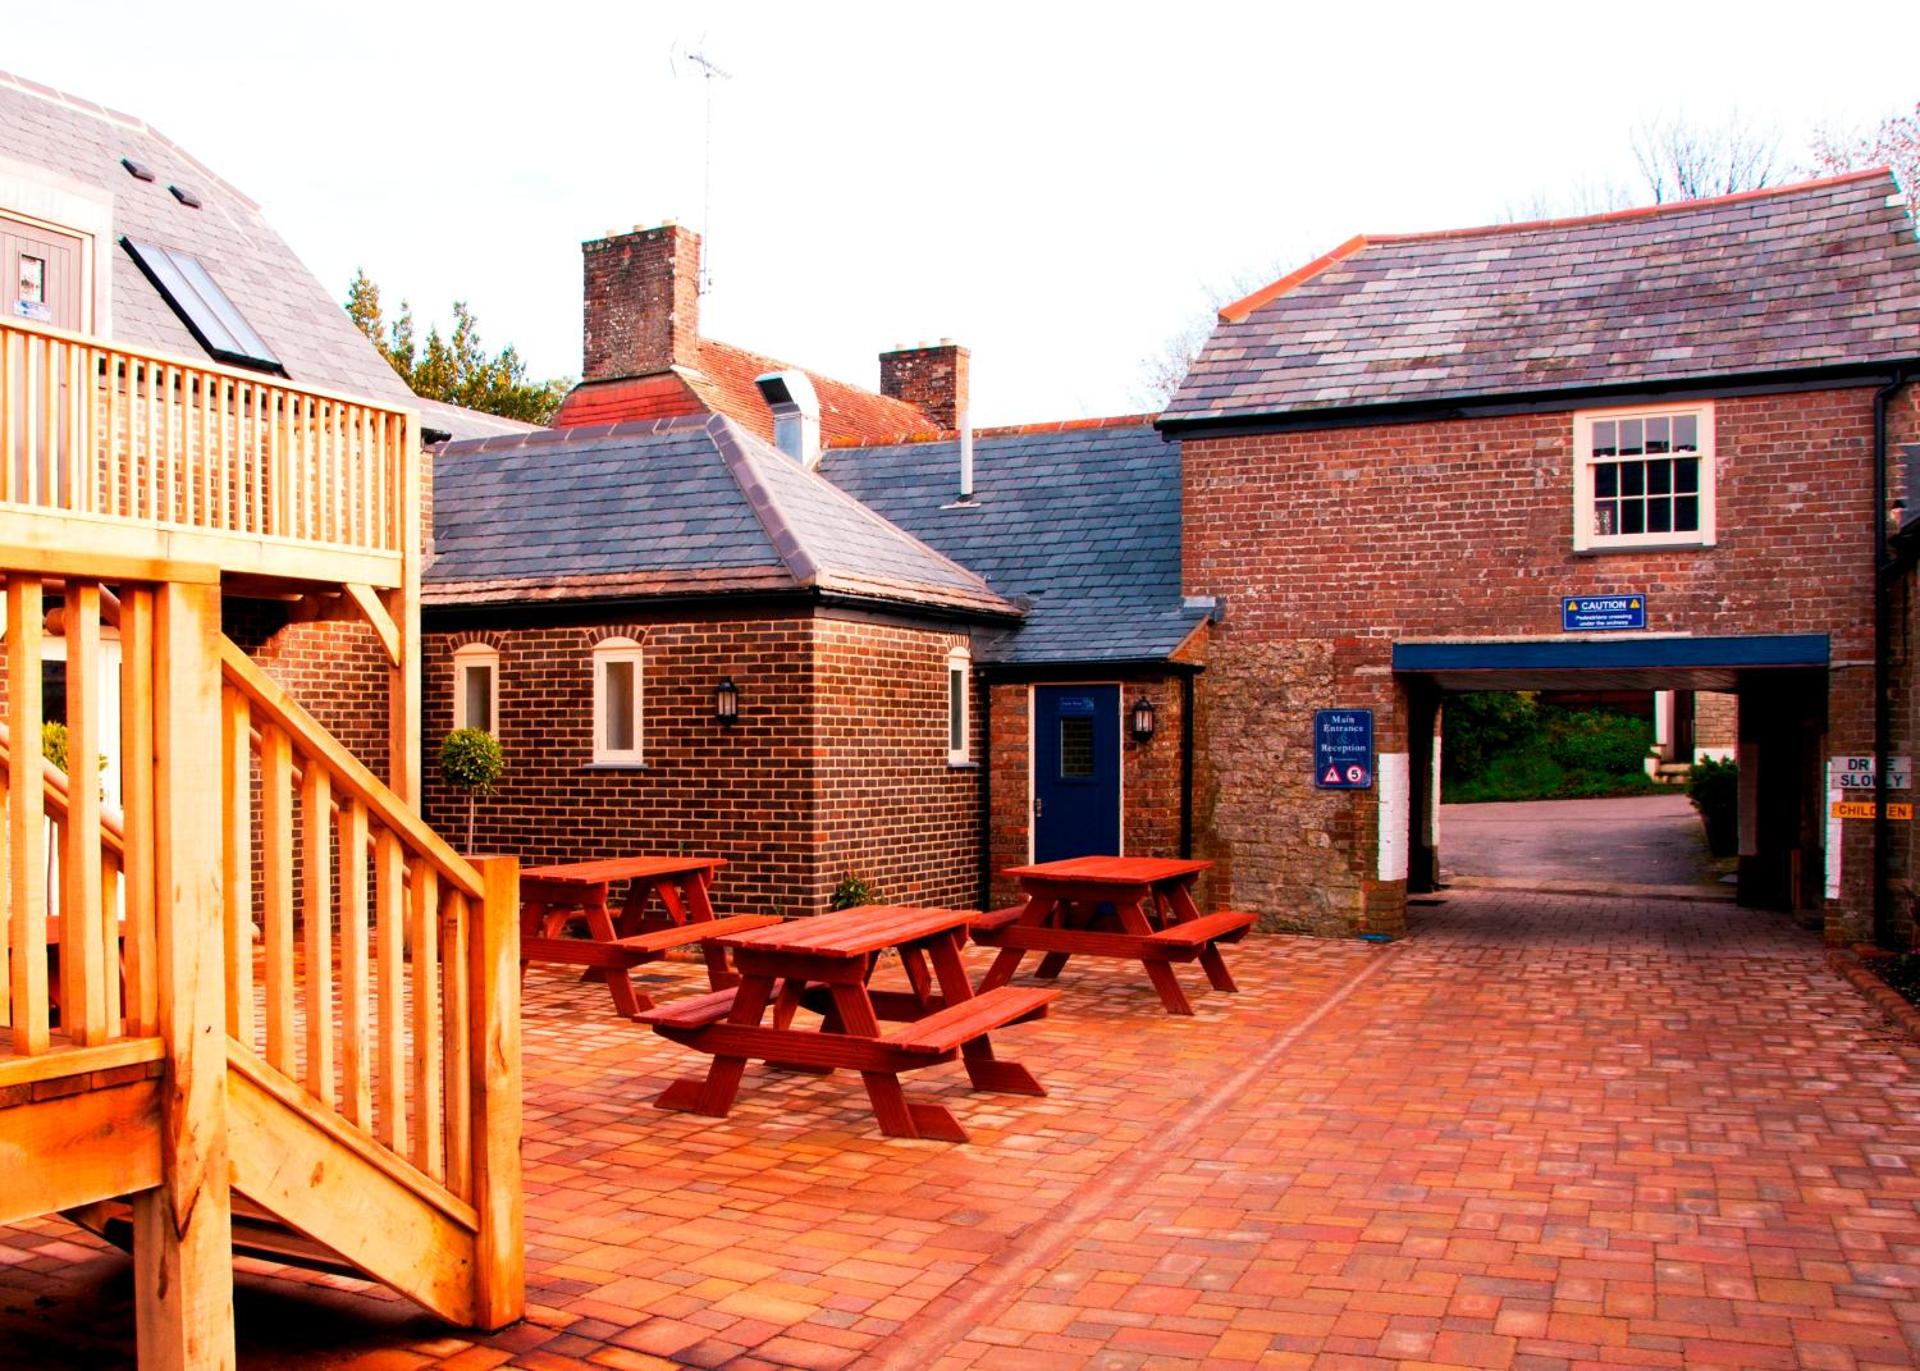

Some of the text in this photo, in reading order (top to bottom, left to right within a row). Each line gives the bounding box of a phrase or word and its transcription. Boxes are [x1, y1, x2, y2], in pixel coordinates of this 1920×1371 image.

[1581, 600, 1627, 610] CAUTION
[1331, 715, 1355, 724] Main
[1323, 724, 1364, 732] Entrance
[1321, 743, 1367, 754] Reception
[1848, 758, 1895, 771] DRE
[1351, 769, 1359, 780] 5
[1840, 774, 1902, 787] SLOY
[1839, 804, 1907, 817] CHILDEN
